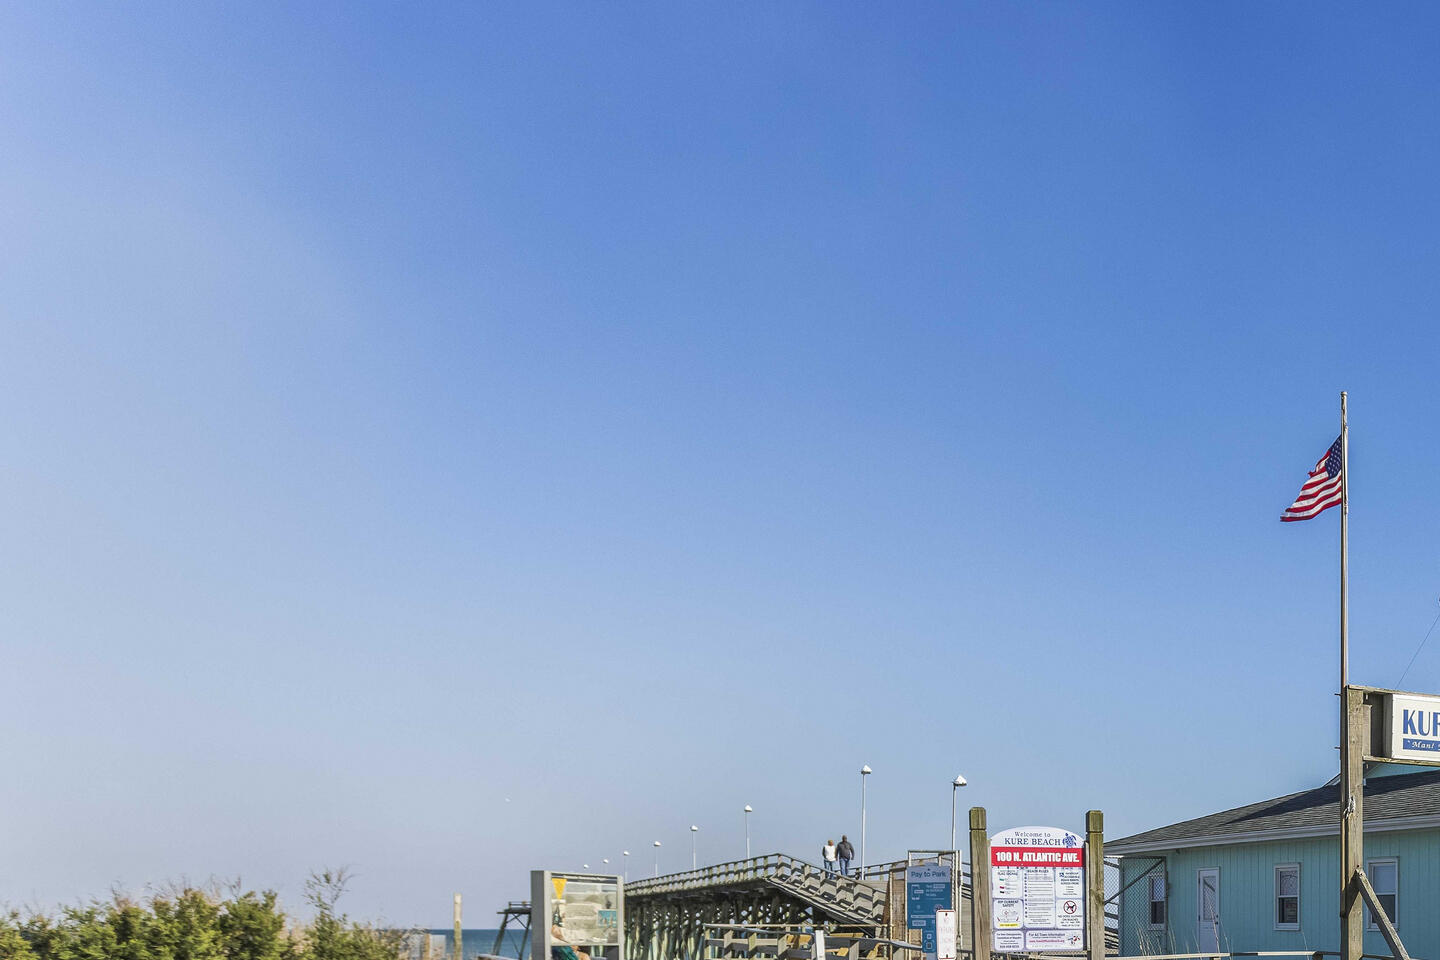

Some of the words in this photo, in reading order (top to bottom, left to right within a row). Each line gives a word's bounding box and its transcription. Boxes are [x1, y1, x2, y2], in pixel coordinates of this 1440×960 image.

[1004, 837, 1029, 845] KURE
[1031, 838, 1061, 846] BEACH
[995, 851, 1012, 862] 100
[1013, 852, 1021, 862] N.
[1022, 852, 1061, 862] ATLANTIC
[1062, 852, 1080, 863] AVE.
[911, 871, 923, 879] Pay
